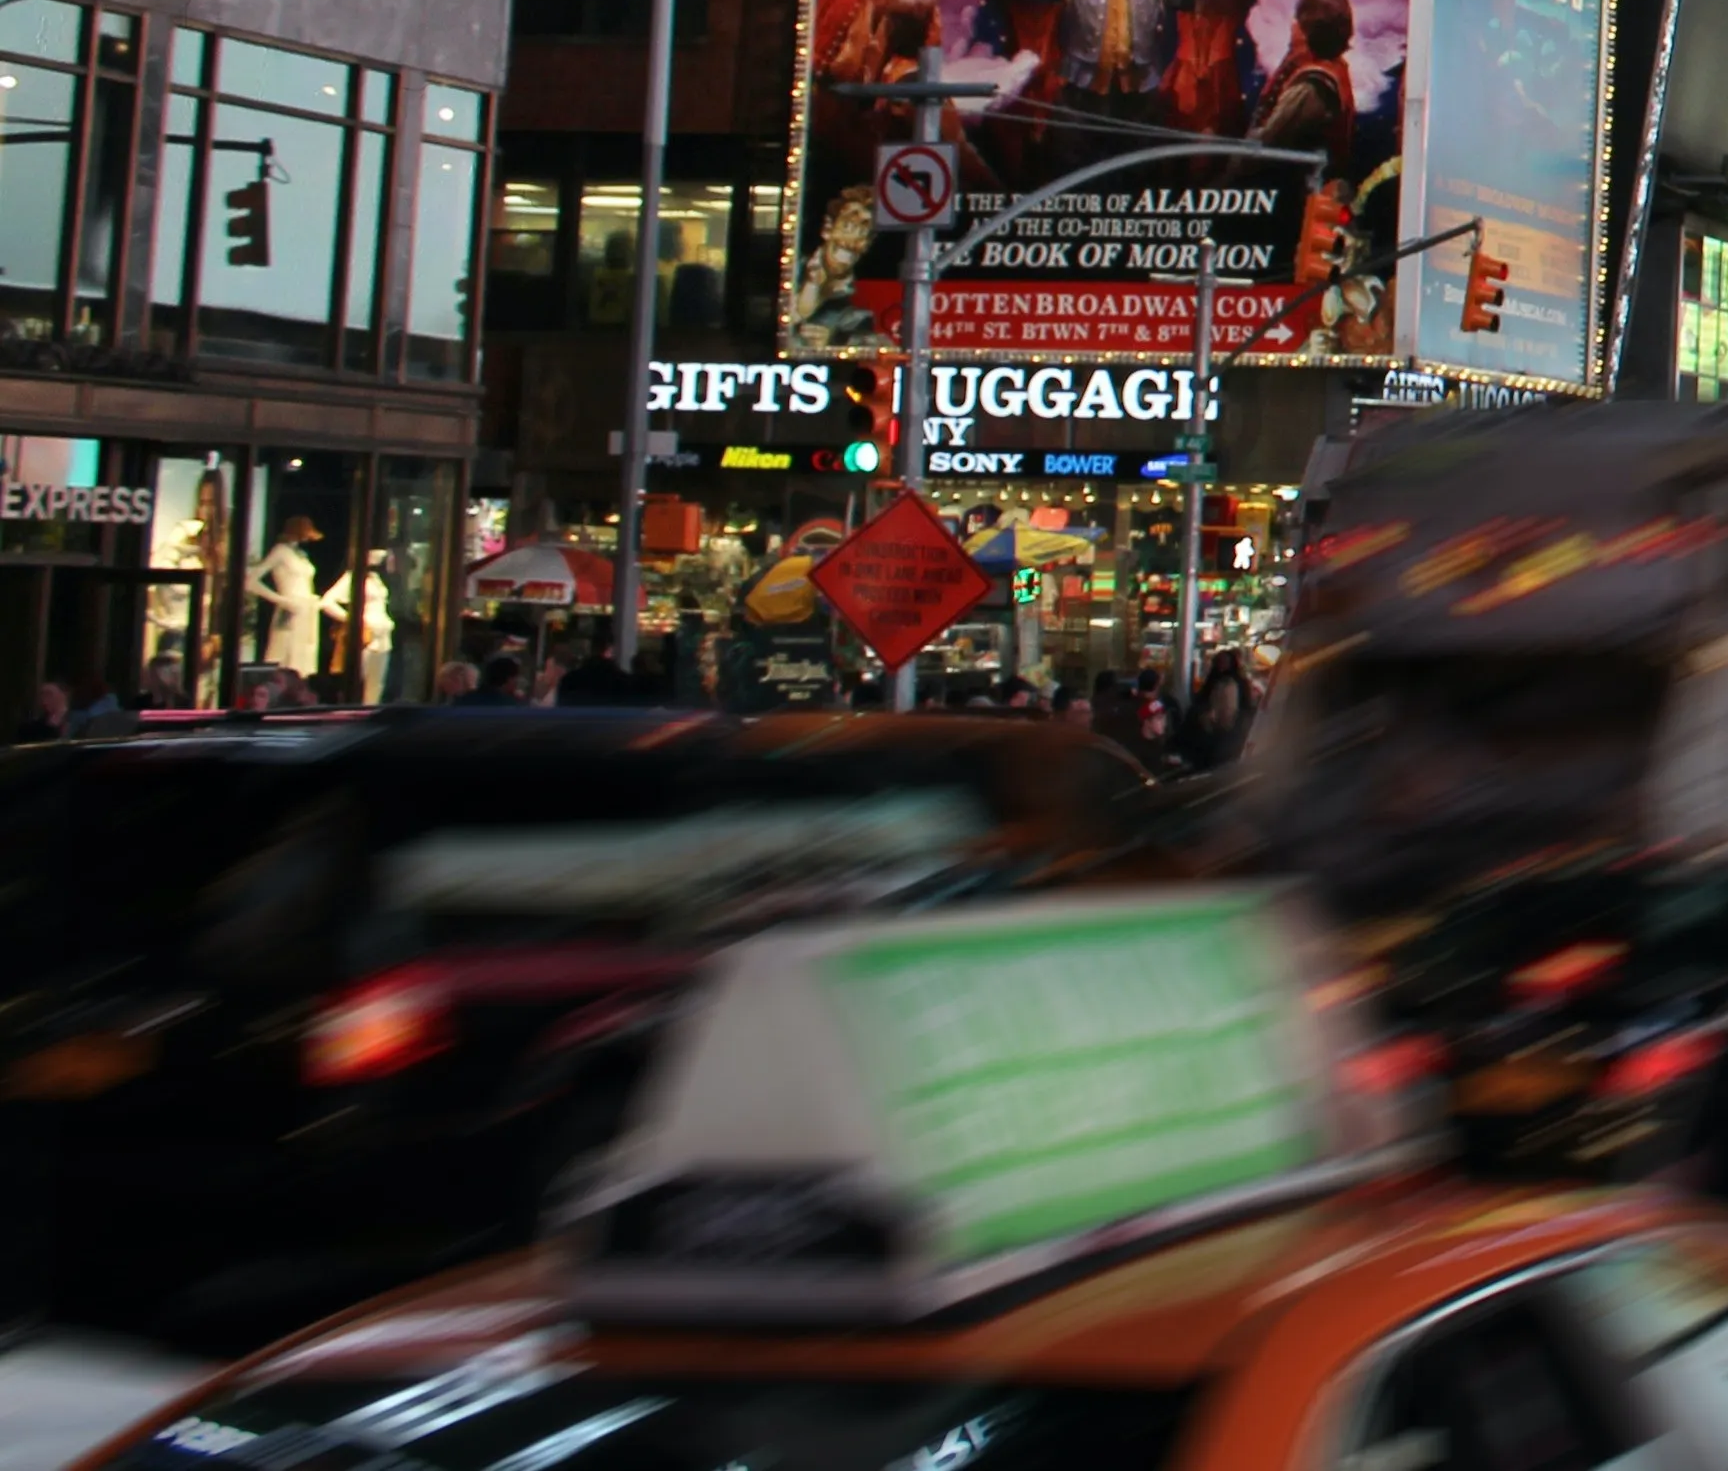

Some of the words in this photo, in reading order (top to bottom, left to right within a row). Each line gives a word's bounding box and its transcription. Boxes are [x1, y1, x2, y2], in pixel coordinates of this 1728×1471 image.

[969, 193, 1005, 211] THE
[1107, 193, 1131, 212] OF
[1133, 189, 1277, 214] ALADDIN
[1014, 219, 1053, 237] THE
[1057, 219, 1181, 237] CO-DIRECTOR
[1187, 219, 1212, 237] OF
[981, 242, 1071, 267] BOOK
[1079, 243, 1122, 267] OF
[1021, 322, 1089, 341] BTWN
[1135, 324, 1151, 341] &
[647, 361, 830, 413] GIFTS
[721, 446, 792, 469] Nikon
[929, 453, 1023, 473] SONY
[1044, 455, 1116, 475] BOWER
[0, 481, 152, 523] EXPRESS
